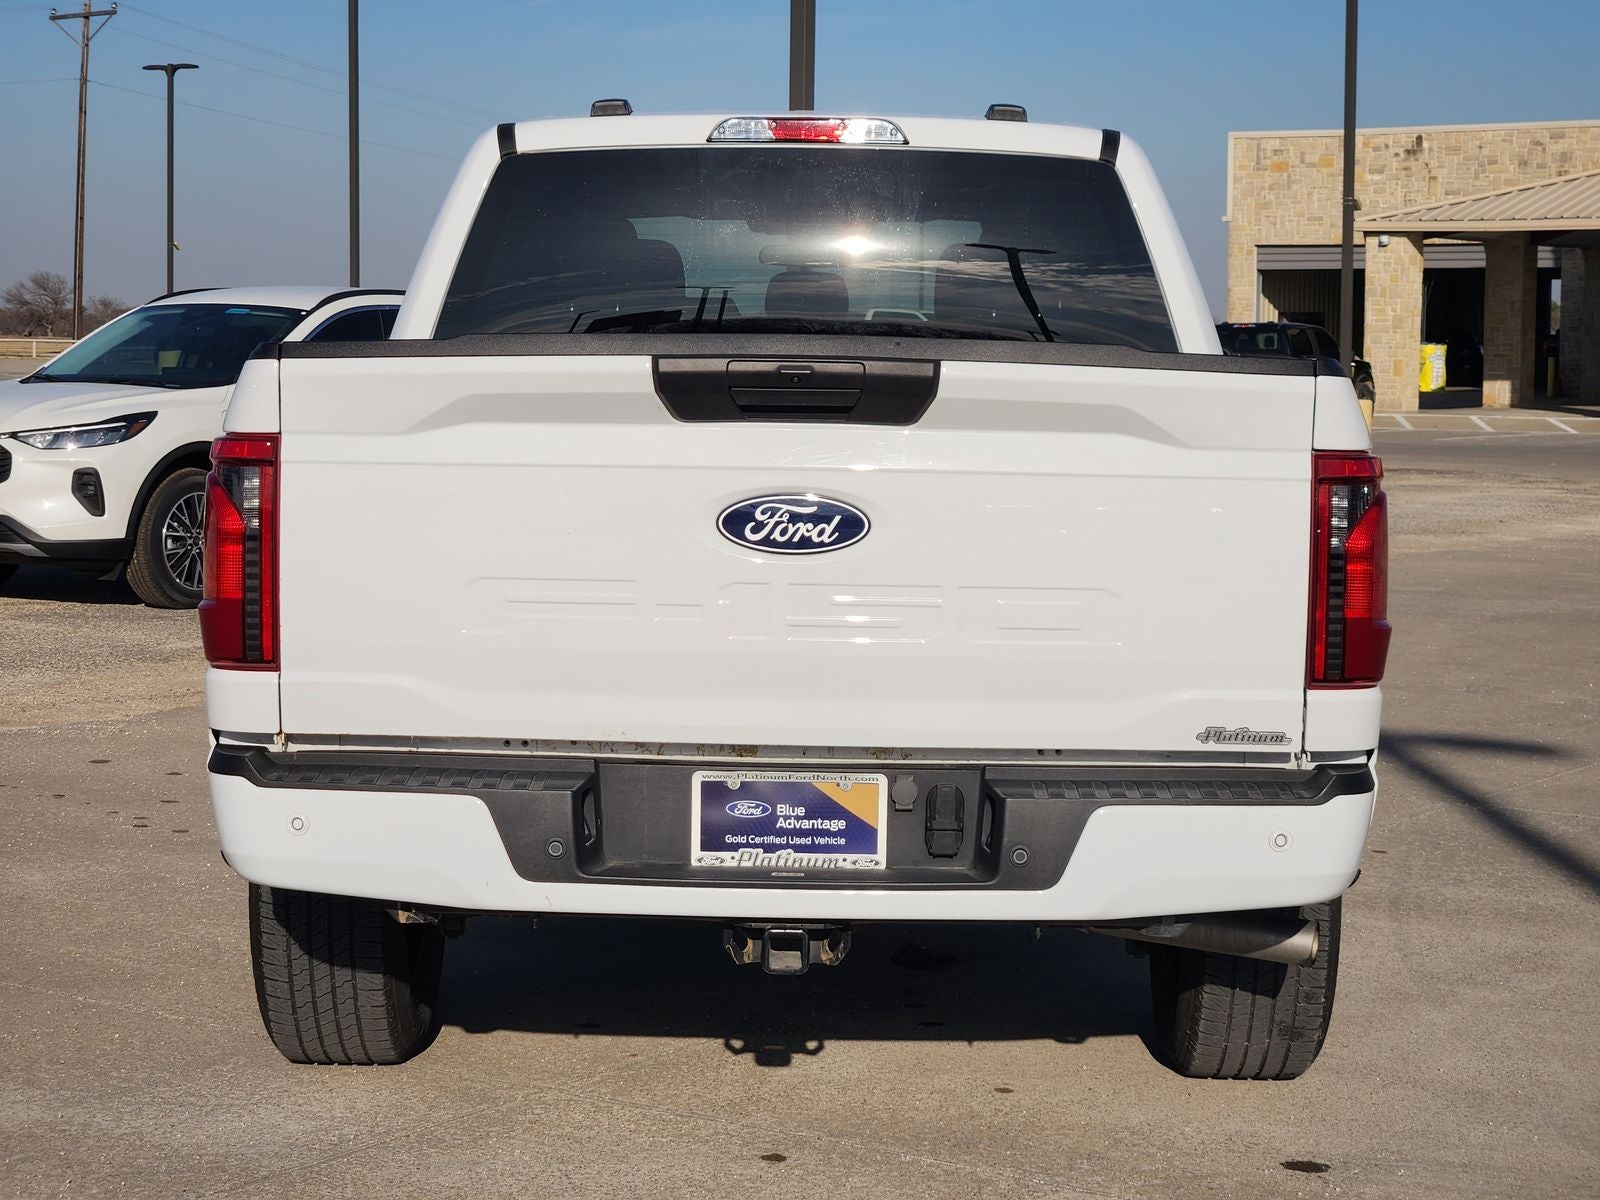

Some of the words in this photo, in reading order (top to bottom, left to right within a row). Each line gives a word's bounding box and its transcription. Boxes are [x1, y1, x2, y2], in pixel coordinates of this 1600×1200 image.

[744, 503, 842, 543] Ford
[1202, 729, 1286, 744] Platinum
[701, 773, 879, 782] www.PlatinumFordNorth.com
[733, 802, 763, 816] Ford
[777, 804, 806, 816] Blue
[776, 817, 846, 831] Advantage
[725, 834, 747, 844] Gold
[748, 834, 787, 844] Certified
[789, 836, 812, 845] Used
[813, 836, 846, 845] Vehicle
[700, 855, 725, 866] Ford
[736, 851, 840, 869] Platinum
[855, 858, 878, 868] Ford
